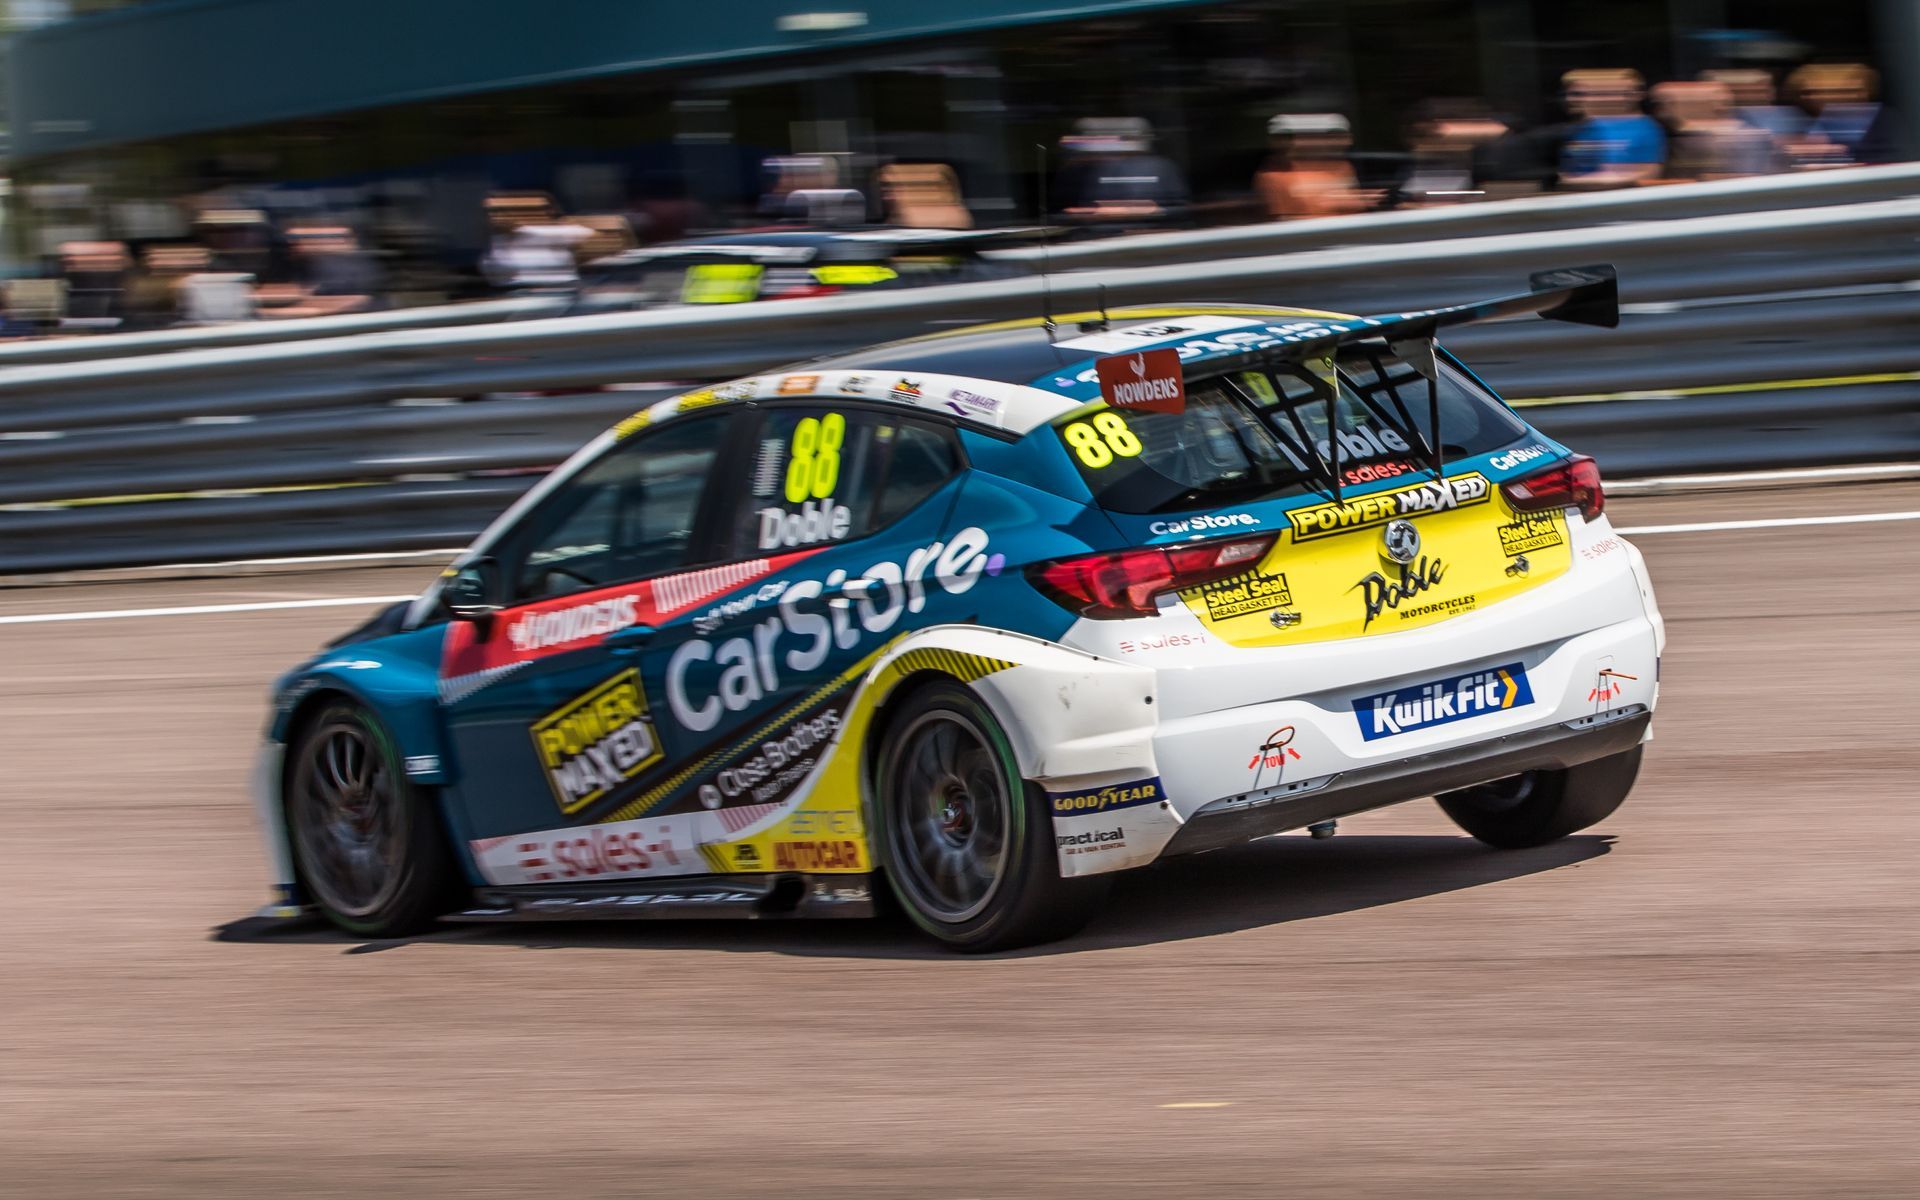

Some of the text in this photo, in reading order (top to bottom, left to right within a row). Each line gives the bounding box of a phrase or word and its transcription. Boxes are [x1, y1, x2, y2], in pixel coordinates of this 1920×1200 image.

[1113, 377, 1179, 405] HOWDENS
[785, 412, 846, 503] 88
[1064, 413, 1143, 468] 88
[755, 498, 851, 549] Doble
[1295, 474, 1488, 535] POWER MAXED
[1500, 517, 1557, 545] Steel Seal
[1505, 543, 1524, 553] HEAD
[1205, 575, 1287, 608] Steel Seal
[1214, 594, 1291, 617] HEAD GASKET FIX
[1343, 554, 1450, 634] Doble
[1399, 594, 1476, 620] MOTORCYCLES
[537, 683, 643, 769] POWER
[551, 719, 656, 804] MAXED
[1264, 753, 1286, 769] TOW
[552, 824, 681, 881] sales-i
[773, 840, 864, 869] AUTOCAR
